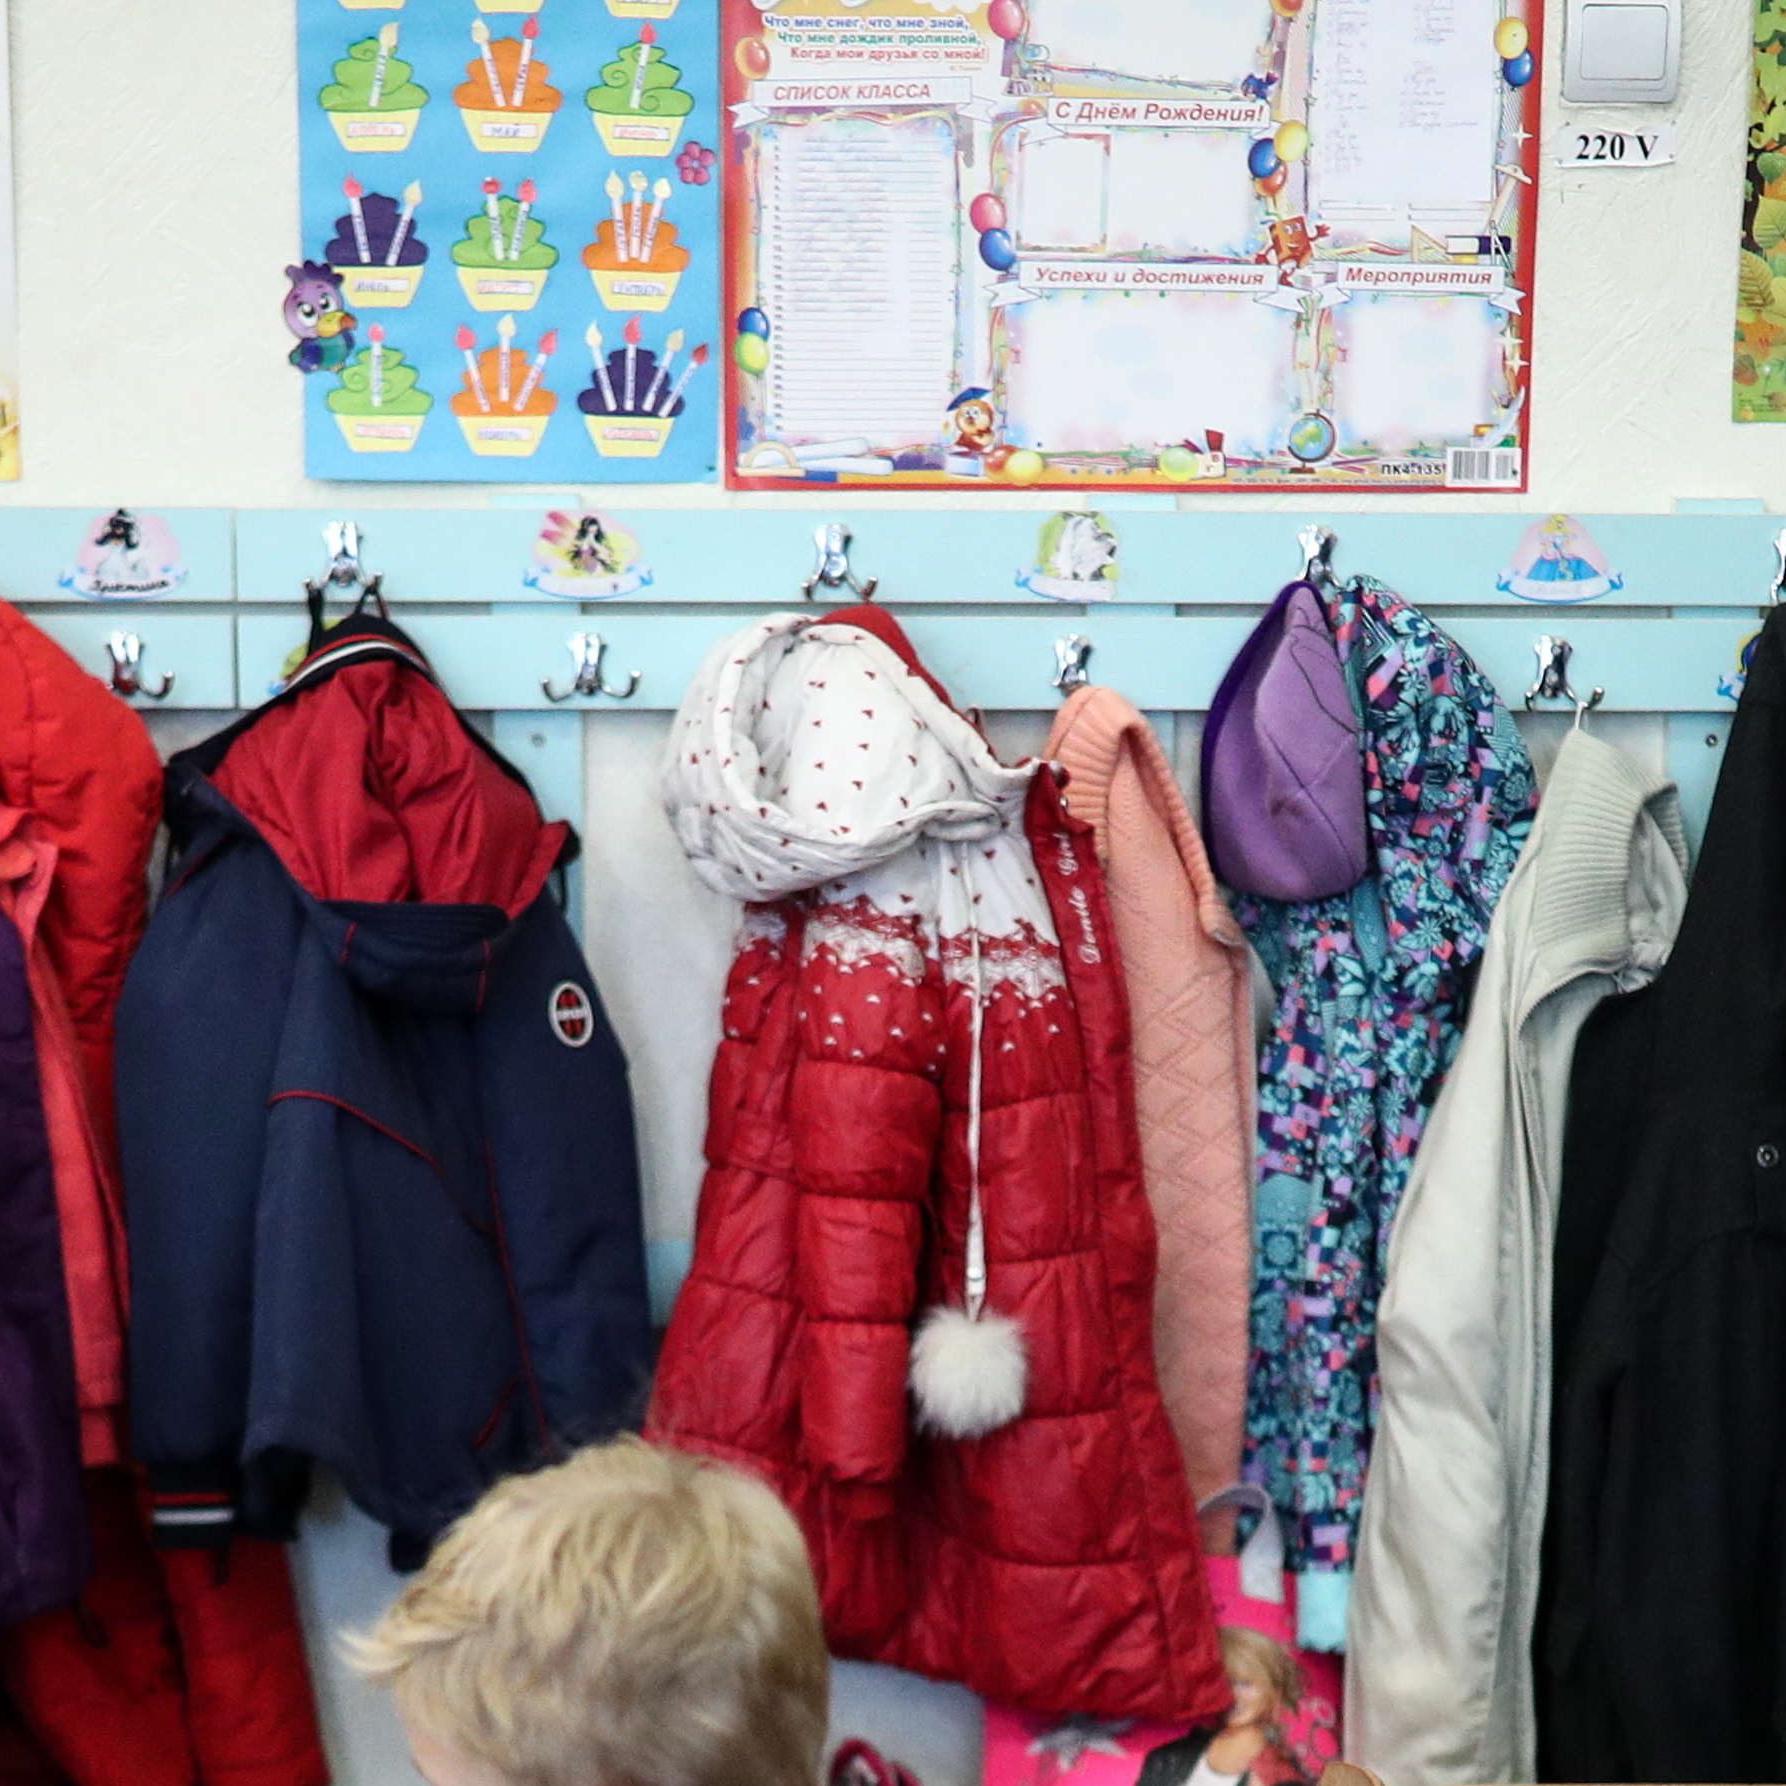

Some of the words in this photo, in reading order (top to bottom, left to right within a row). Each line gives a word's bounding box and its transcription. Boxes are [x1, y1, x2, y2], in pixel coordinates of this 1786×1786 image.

[764, 15, 790, 28] Что
[795, 18, 822, 28] мне
[827, 18, 864, 31] снег,
[868, 18, 892, 28] что
[896, 19, 924, 28] мне
[929, 17, 969, 30] зной,
[777, 32, 803, 44] Что
[807, 34, 835, 44] мне
[839, 35, 894, 47] дождик
[899, 33, 982, 46] проливной,
[790, 47, 832, 61] Когда
[837, 49, 864, 59] мои
[868, 50, 919, 63] друзья
[922, 50, 940, 60] со
[944, 48, 986, 60] мной!
[773, 84, 852, 101] СПИСОК
[855, 83, 932, 99] КЛАССА
[1055, 101, 1072, 118] С
[1075, 101, 1138, 123] Днём
[1143, 103, 1266, 122] Рождения!
[1575, 133, 1625, 160] 220
[1635, 135, 1660, 160] V
[1034, 266, 1109, 287] Успехи
[1113, 271, 1126, 284] и
[1131, 268, 1266, 287] достижения
[1344, 266, 1494, 287] Мероприятия
